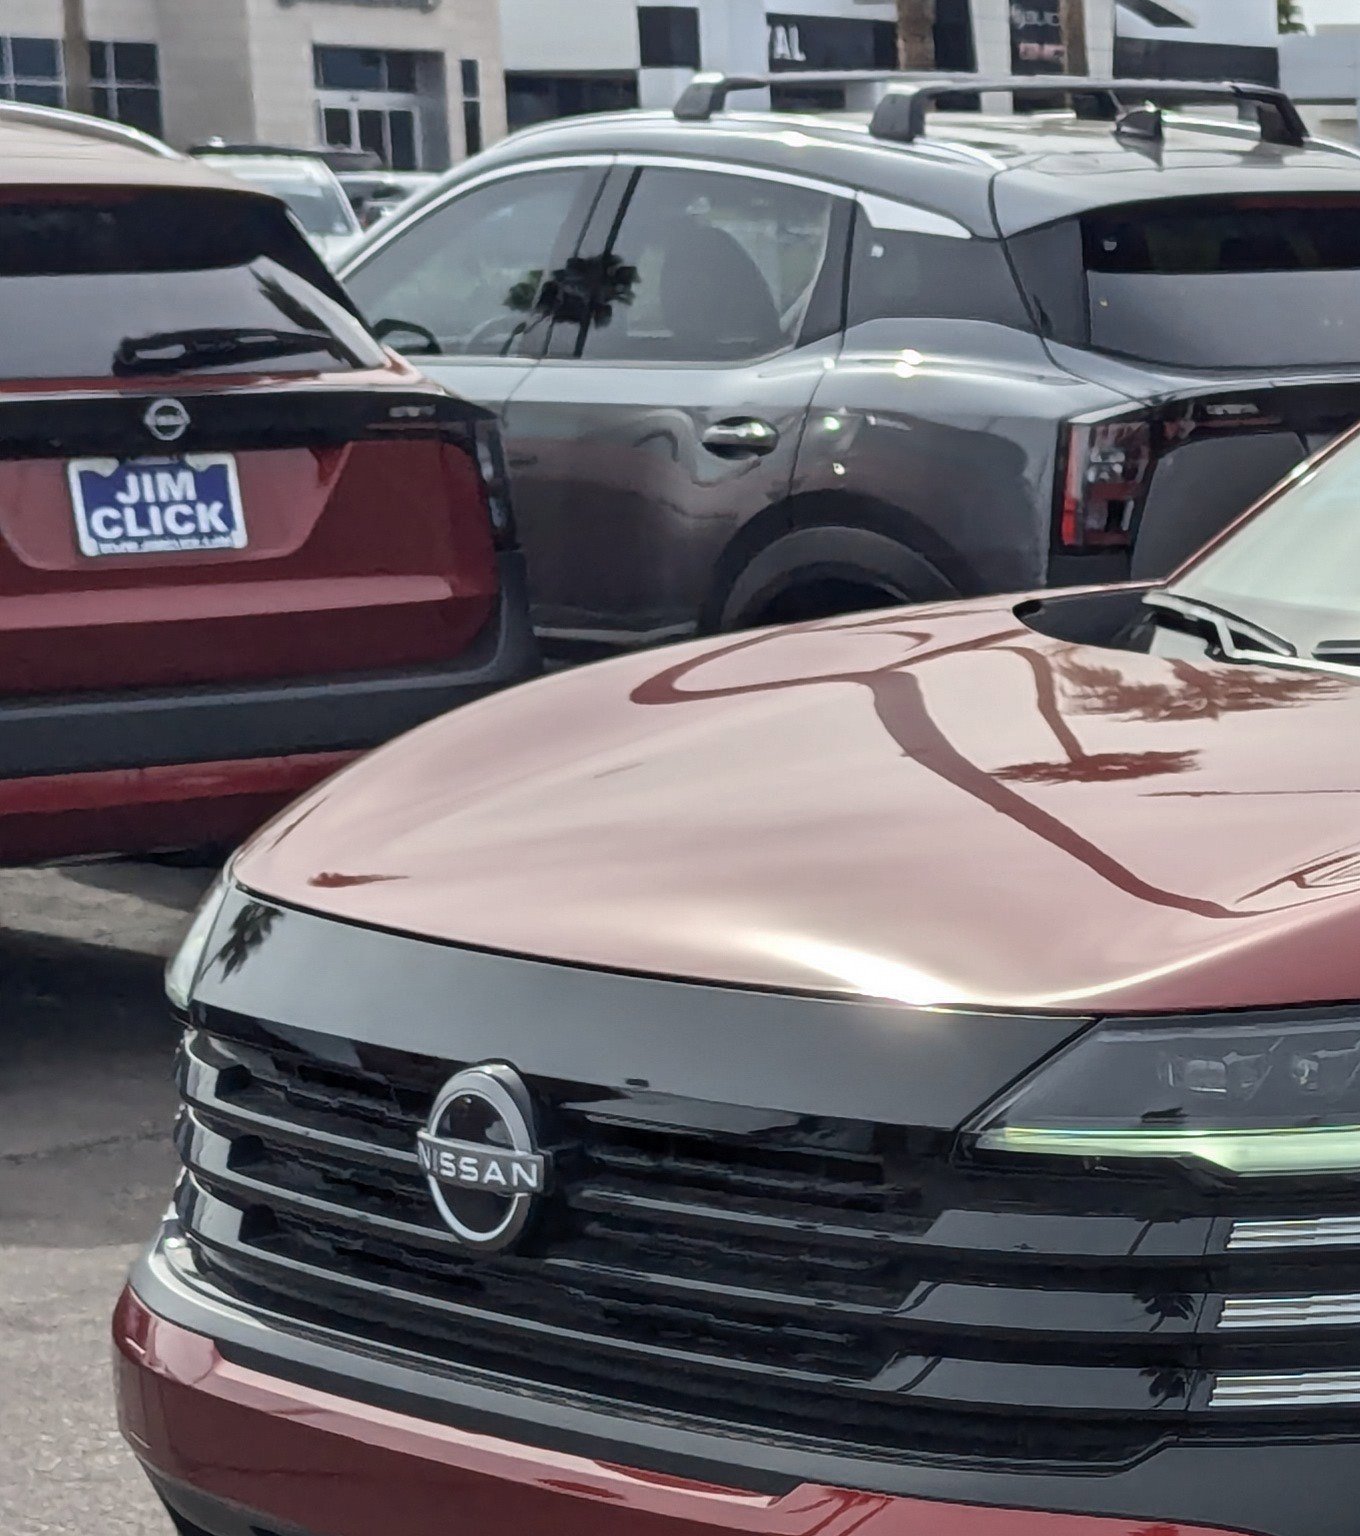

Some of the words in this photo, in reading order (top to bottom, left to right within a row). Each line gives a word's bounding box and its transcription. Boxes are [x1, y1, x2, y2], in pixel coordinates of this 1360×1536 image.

[115, 471, 198, 505] JIM
[90, 501, 231, 540] CLICK
[417, 1140, 539, 1188] NISSAN
